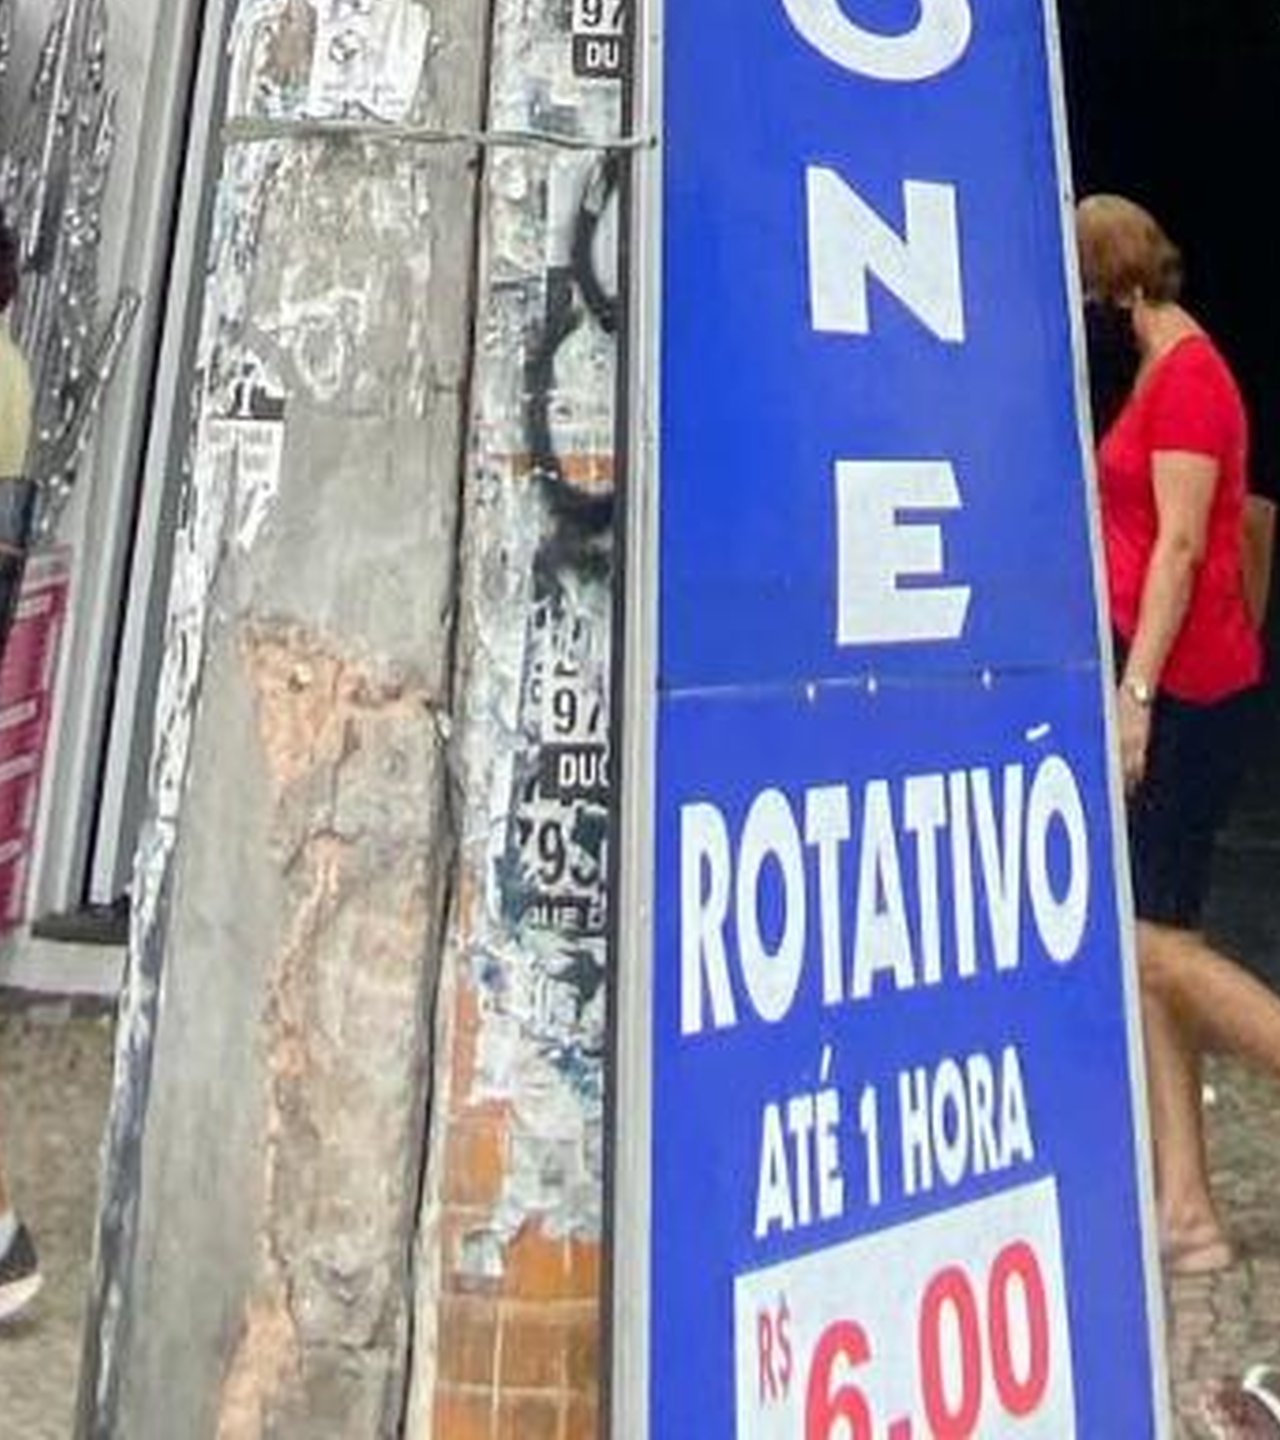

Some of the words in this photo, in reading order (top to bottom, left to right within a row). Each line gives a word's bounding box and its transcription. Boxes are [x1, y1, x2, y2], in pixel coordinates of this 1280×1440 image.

[754, 1046, 845, 1239] ATÉ
[860, 1086, 881, 1207] 1
[899, 1046, 1034, 1196] HORA
[757, 1294, 794, 1406] R$
